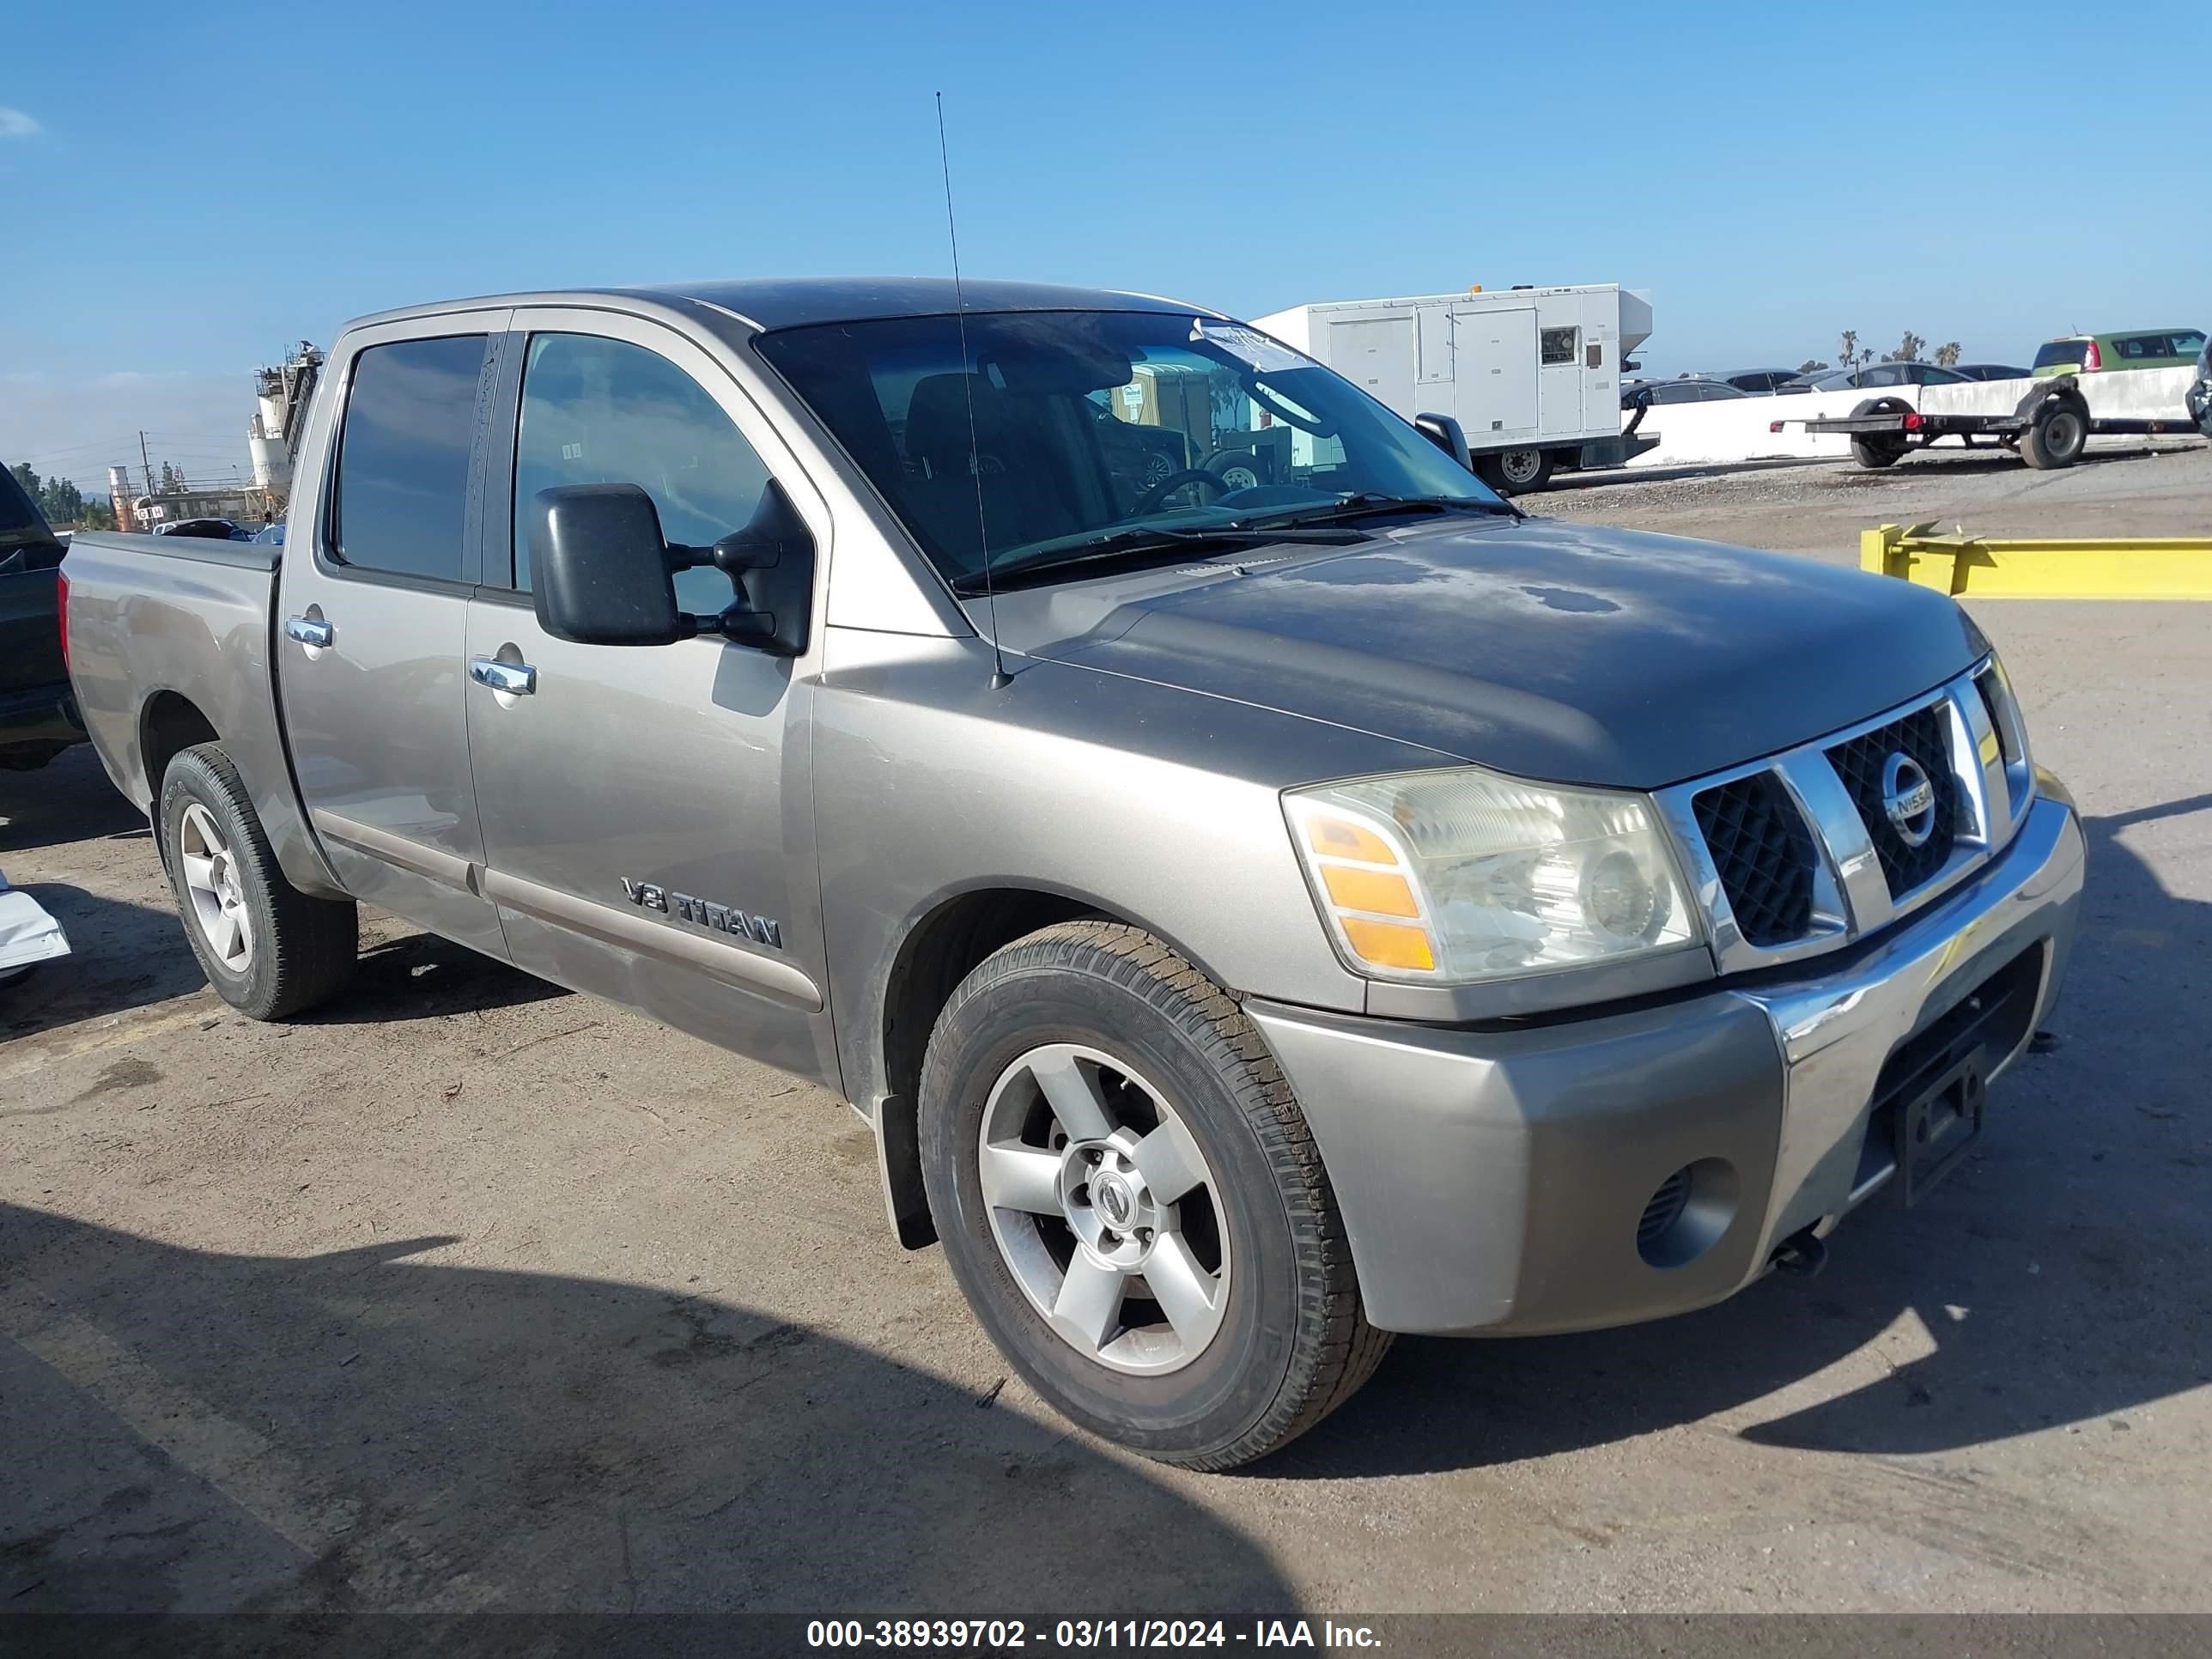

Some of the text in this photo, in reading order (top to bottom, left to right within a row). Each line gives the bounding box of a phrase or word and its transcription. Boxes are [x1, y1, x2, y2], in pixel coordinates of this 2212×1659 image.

[1896, 787, 1932, 815] NISS
[621, 876, 783, 949] V8 TITAN
